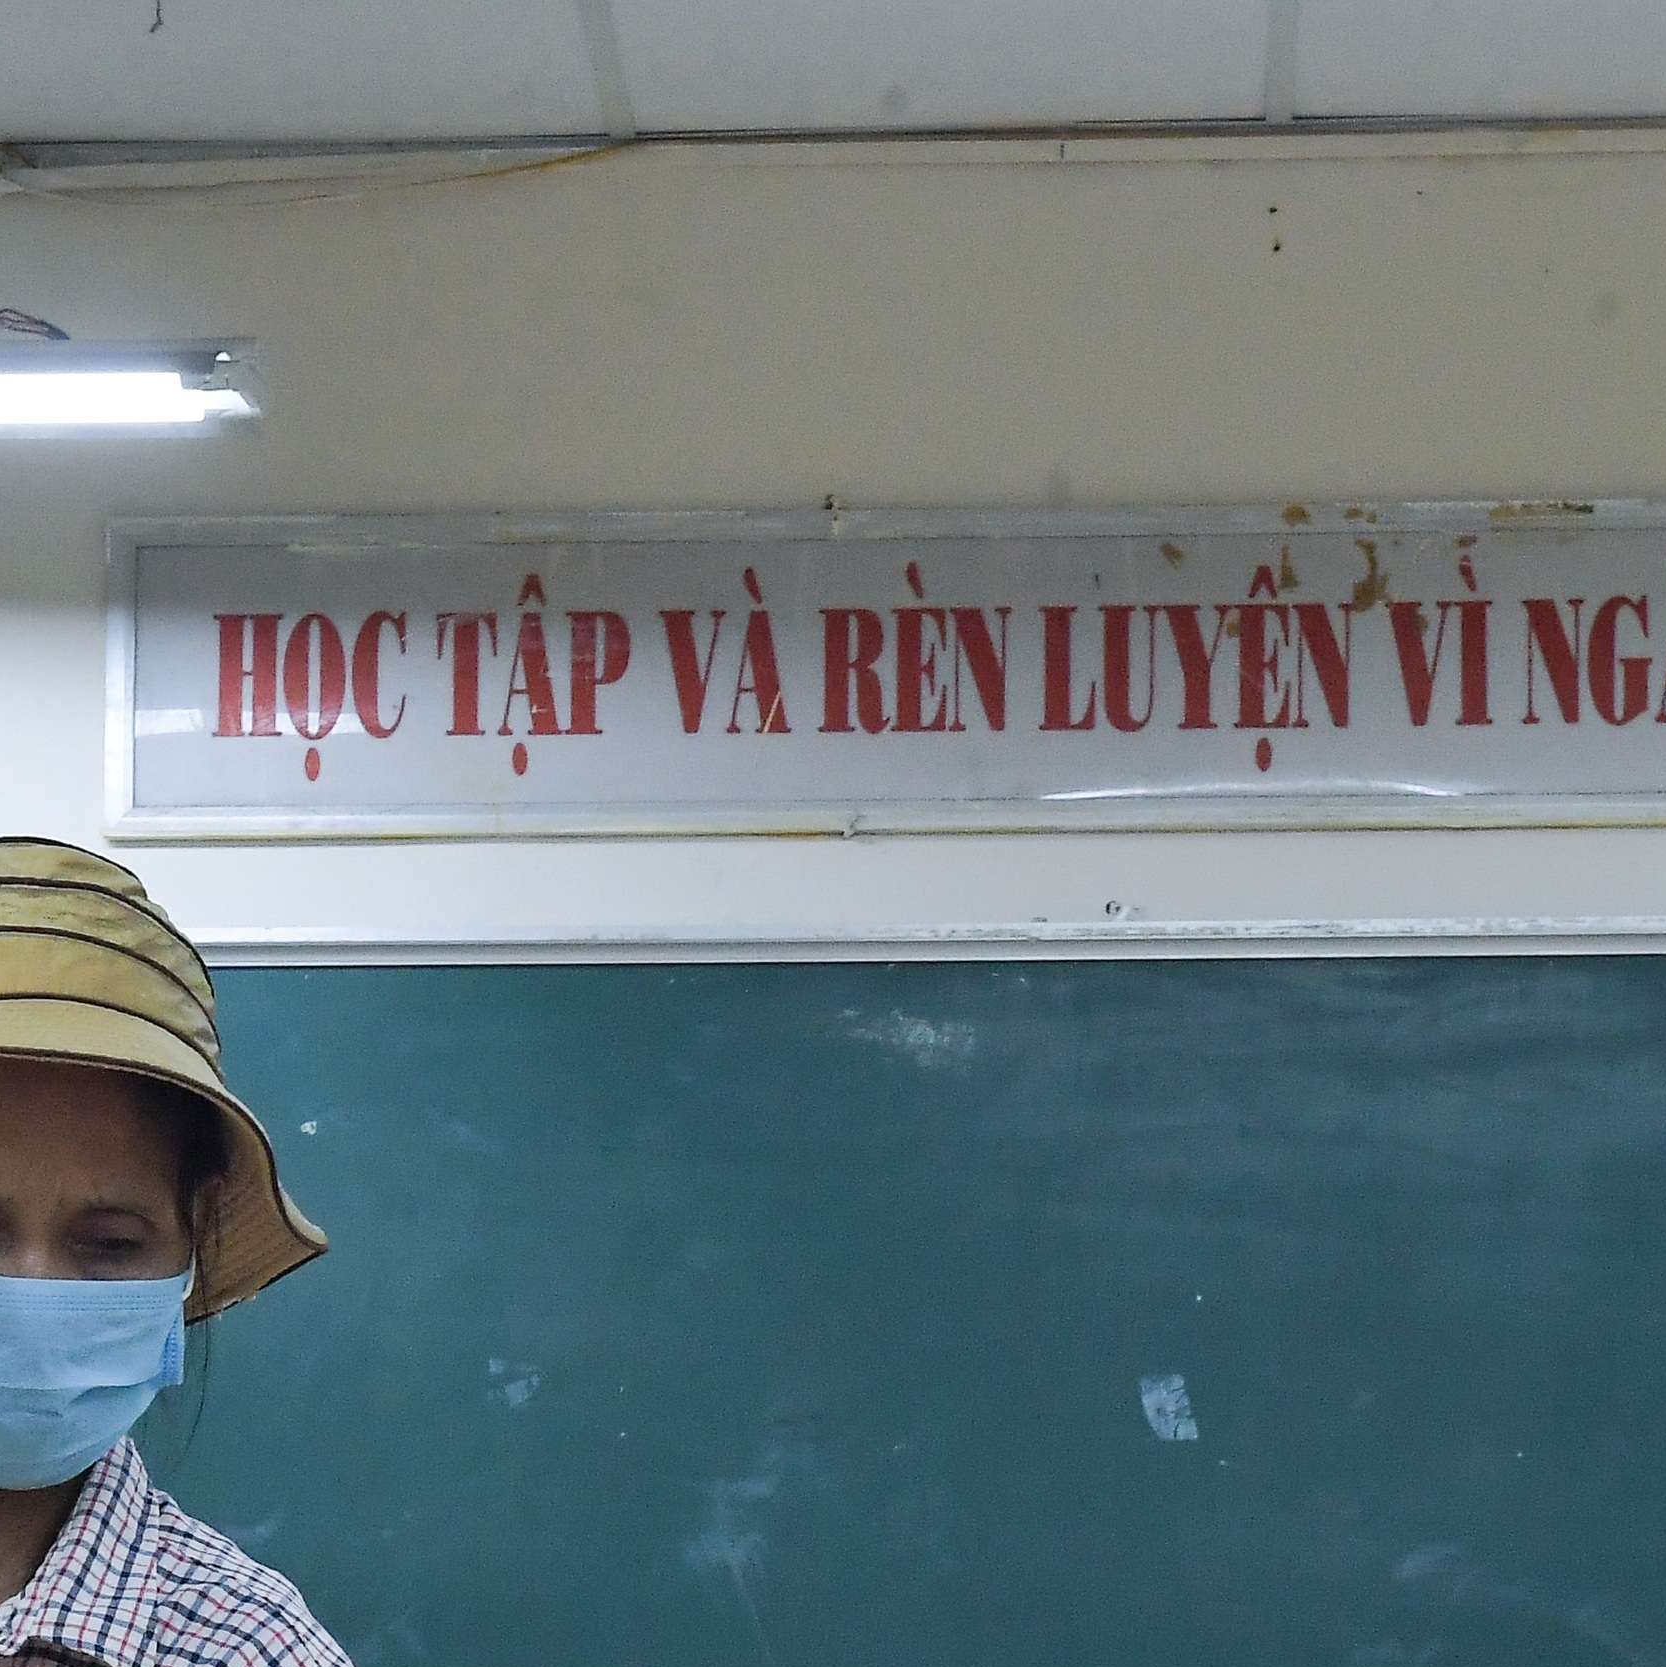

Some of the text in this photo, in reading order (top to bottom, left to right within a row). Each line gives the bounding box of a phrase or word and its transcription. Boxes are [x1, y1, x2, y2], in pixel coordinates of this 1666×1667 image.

[211, 611, 407, 782] HỌC
[436, 573, 631, 777] TẬP
[659, 567, 794, 737] VÀ
[817, 561, 1012, 735] RÈN
[1038, 564, 1353, 775] LUYỆN
[1389, 553, 1494, 728] VÌ
